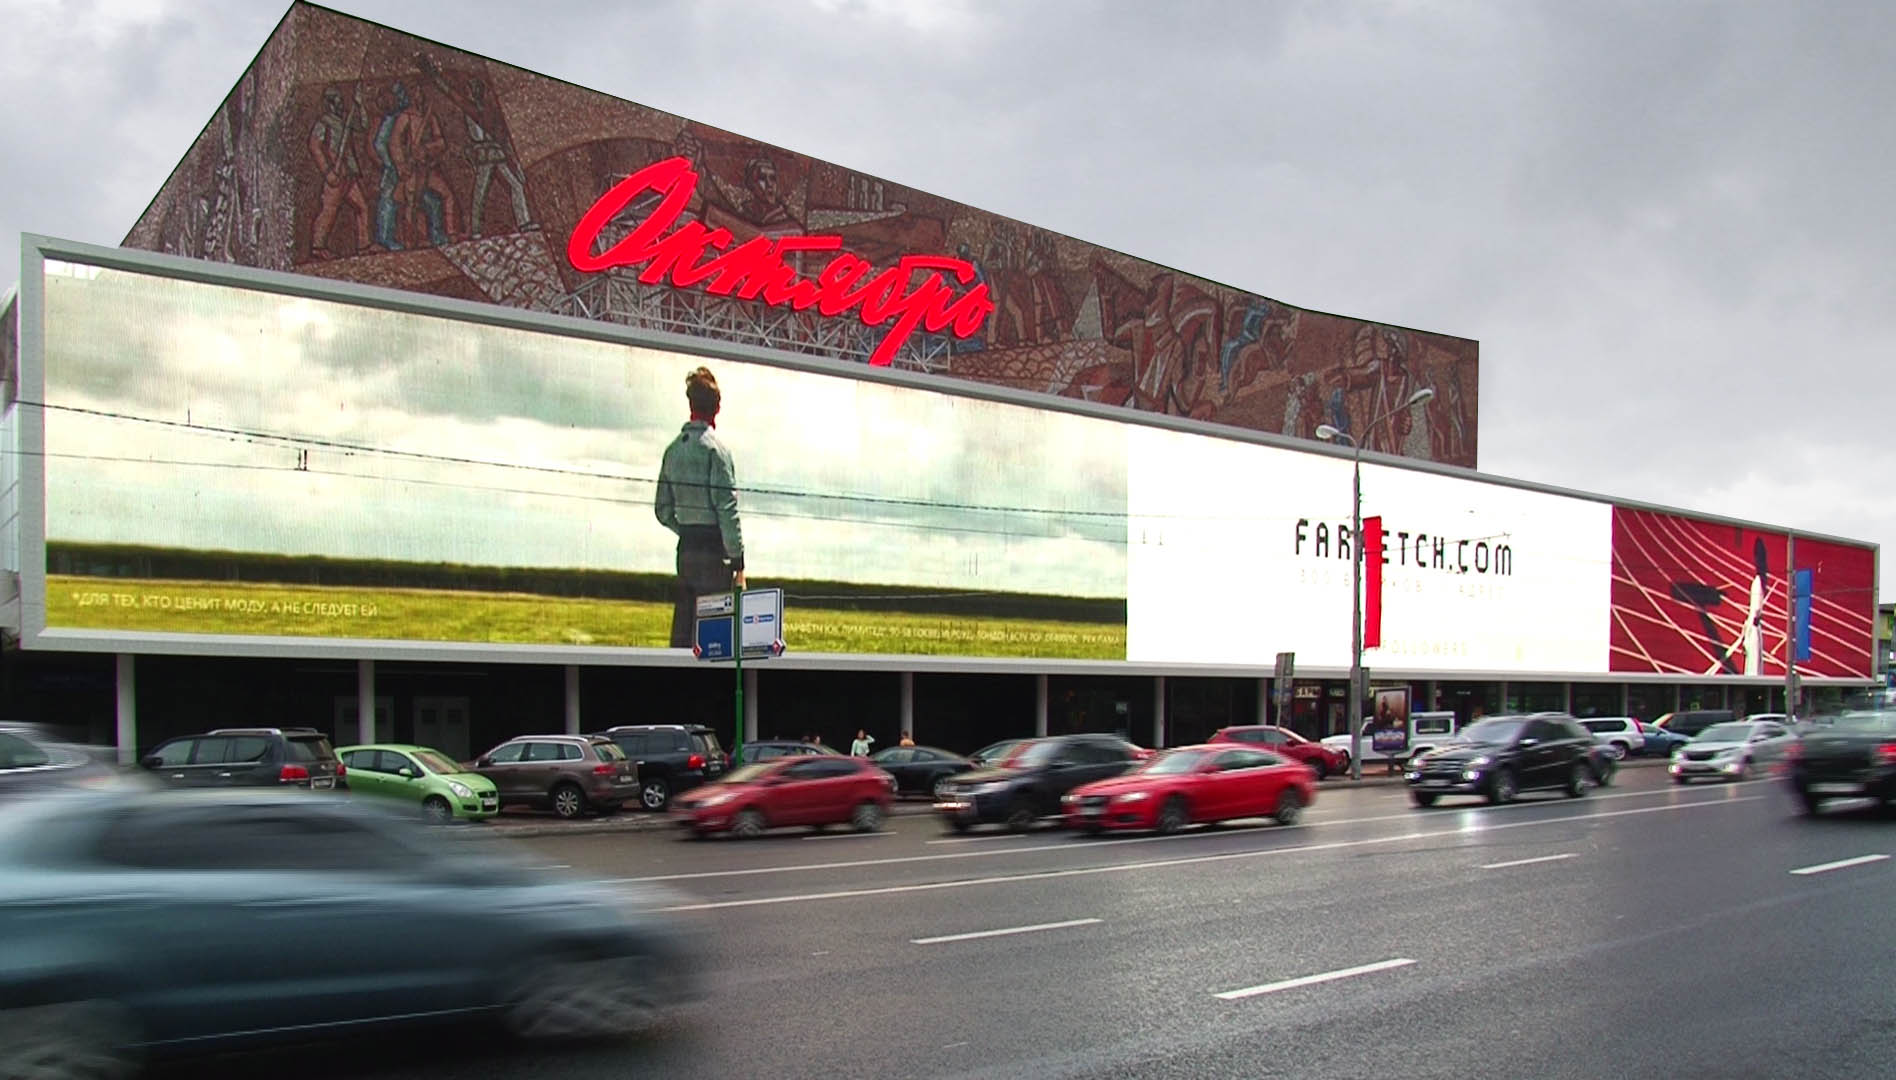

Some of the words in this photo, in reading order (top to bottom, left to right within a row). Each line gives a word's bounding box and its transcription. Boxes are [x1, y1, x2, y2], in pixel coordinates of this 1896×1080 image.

[568, 156, 995, 366] Октябрь
[1296, 518, 1511, 575] FARETCH.COM
[143, 595, 172, 609] КТО
[174, 597, 220, 611] ЦЕНИТ
[271, 600, 280, 613] А
[283, 601, 300, 614] НЕ
[303, 602, 357, 617] СЛЕДУЕТ
[361, 602, 378, 616] ЕЙ
